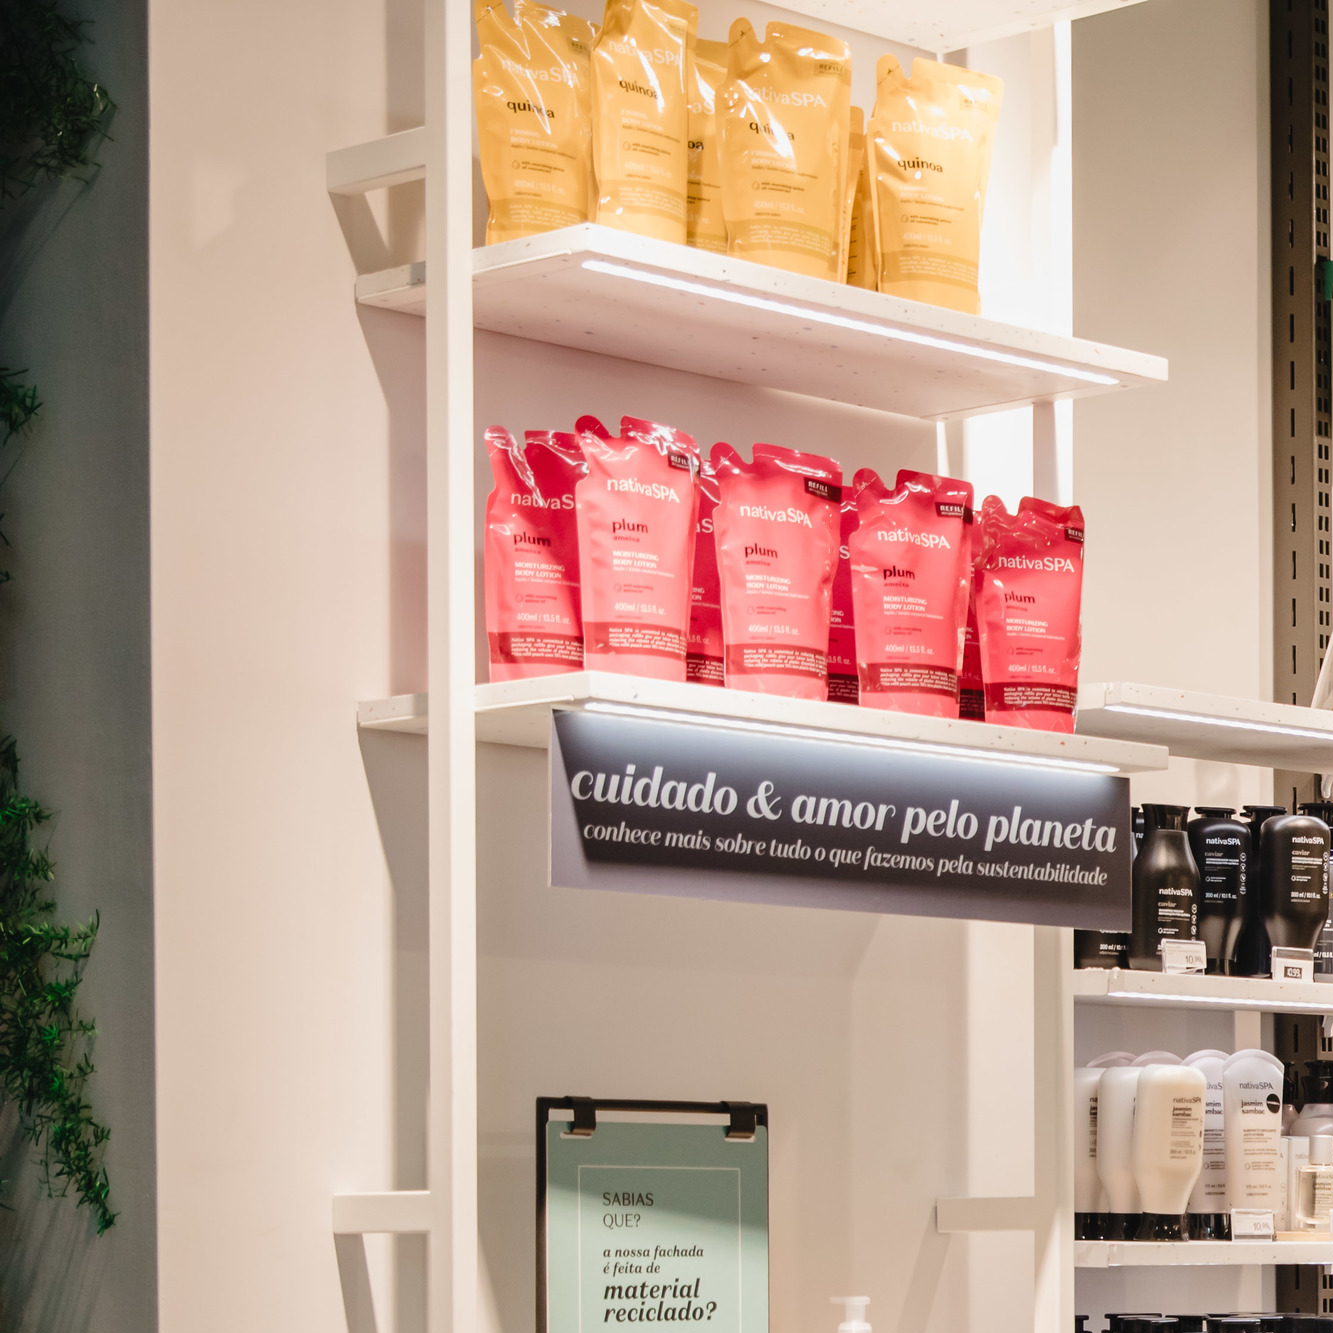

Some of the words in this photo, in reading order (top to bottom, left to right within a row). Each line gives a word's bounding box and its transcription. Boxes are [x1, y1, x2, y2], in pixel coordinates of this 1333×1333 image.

[898, 157, 943, 173] quinoa
[607, 478, 680, 504] nativaSPA
[740, 505, 812, 528] nativaSPA
[613, 519, 649, 533] plum
[514, 532, 551, 547] plum
[878, 528, 950, 549] nativaSPA
[744, 543, 778, 559] plum
[998, 555, 1075, 573] nativaSPA
[883, 566, 915, 580] plum
[1004, 591, 1035, 604] plum
[571, 764, 738, 815] cuidado
[746, 780, 782, 820] &
[791, 794, 896, 831] amor
[900, 799, 979, 843] pelo
[984, 806, 1117, 853] planeta
[1292, 836, 1324, 845] nativaSPA
[583, 821, 662, 845] conhece
[665, 829, 711, 850] mais
[714, 833, 766, 855] sobre
[769, 839, 811, 860] tudo
[814, 850, 826, 861] o
[829, 847, 862, 868] que
[864, 846, 935, 871] fazemos
[937, 854, 974, 877] pela
[976, 861, 1108, 886] sustentabilidade
[1159, 888, 1193, 897] nativaSPA
[1239, 1082, 1273, 1090] nativaSPA
[603, 1192, 654, 1206] SABIAS
[603, 1214, 641, 1229] QUE?
[603, 1249, 611, 1257] a
[615, 1248, 650, 1257] nossa
[653, 1245, 704, 1261] fachada
[603, 1262, 609, 1274] é
[613, 1262, 642, 1277] feita
[646, 1261, 661, 1274] de
[604, 1278, 701, 1300] material
[604, 1300, 717, 1324] reciclado?
